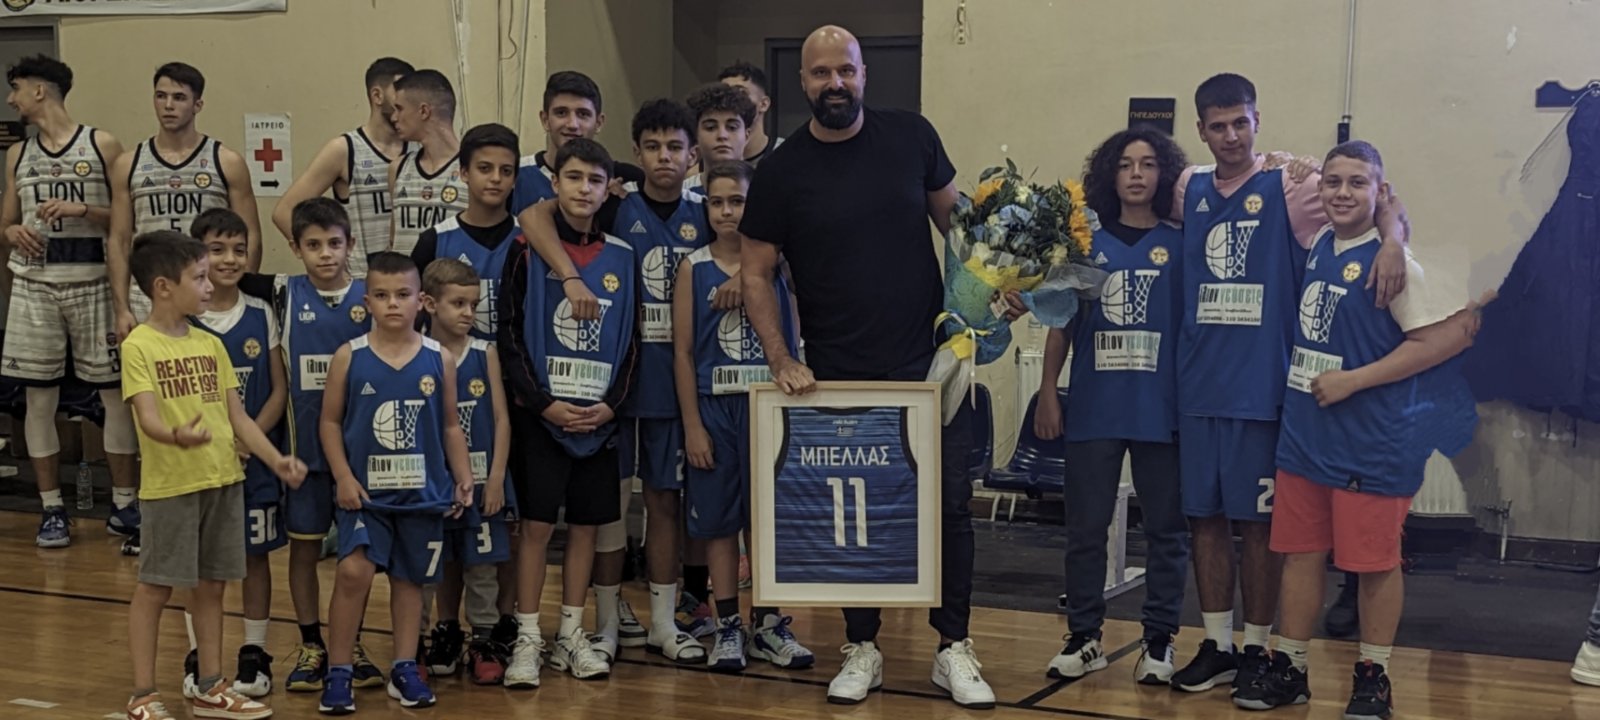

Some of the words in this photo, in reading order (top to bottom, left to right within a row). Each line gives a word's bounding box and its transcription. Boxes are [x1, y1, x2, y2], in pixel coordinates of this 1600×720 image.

[148, 192, 202, 216] ILION
[1225, 222, 1235, 278] ILION
[1124, 270, 1133, 325] ILION
[1311, 282, 1326, 341] ILION
[155, 355, 218, 379] REACTION
[158, 376, 200, 399] TIME
[395, 400, 405, 449] ILION
[800, 446, 890, 466] ΜΠΕΛΛΑΣ
[826, 477, 868, 547] 11
[1257, 478, 1275, 513] 2
[476, 522, 493, 554] 3
[425, 541, 443, 577] 7
